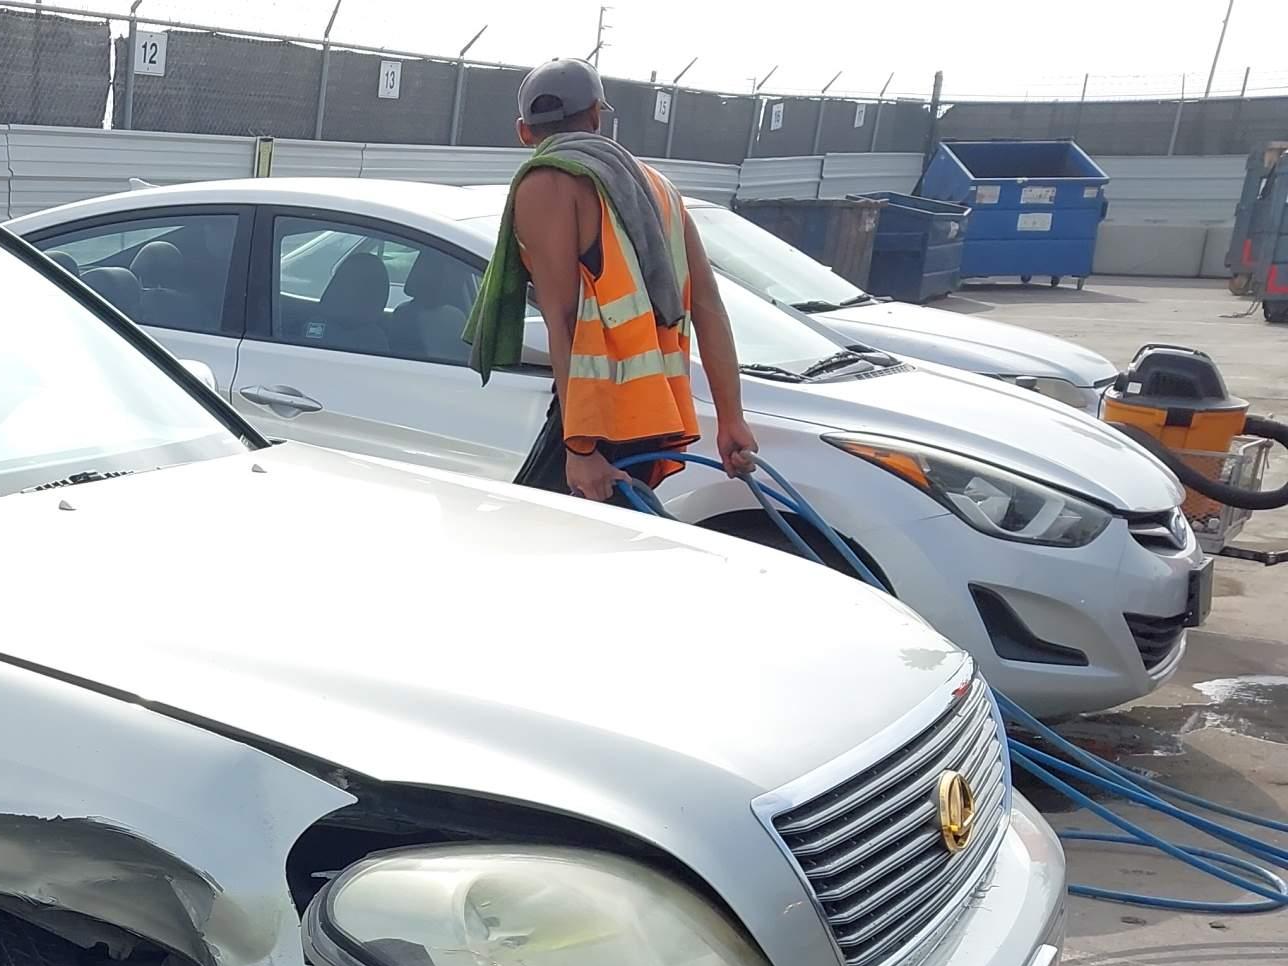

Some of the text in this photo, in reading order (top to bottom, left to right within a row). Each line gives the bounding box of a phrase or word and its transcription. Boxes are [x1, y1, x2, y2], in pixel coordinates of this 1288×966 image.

[141, 41, 158, 65] 12
[384, 70, 395, 90] 13
[659, 99, 667, 115] 15
